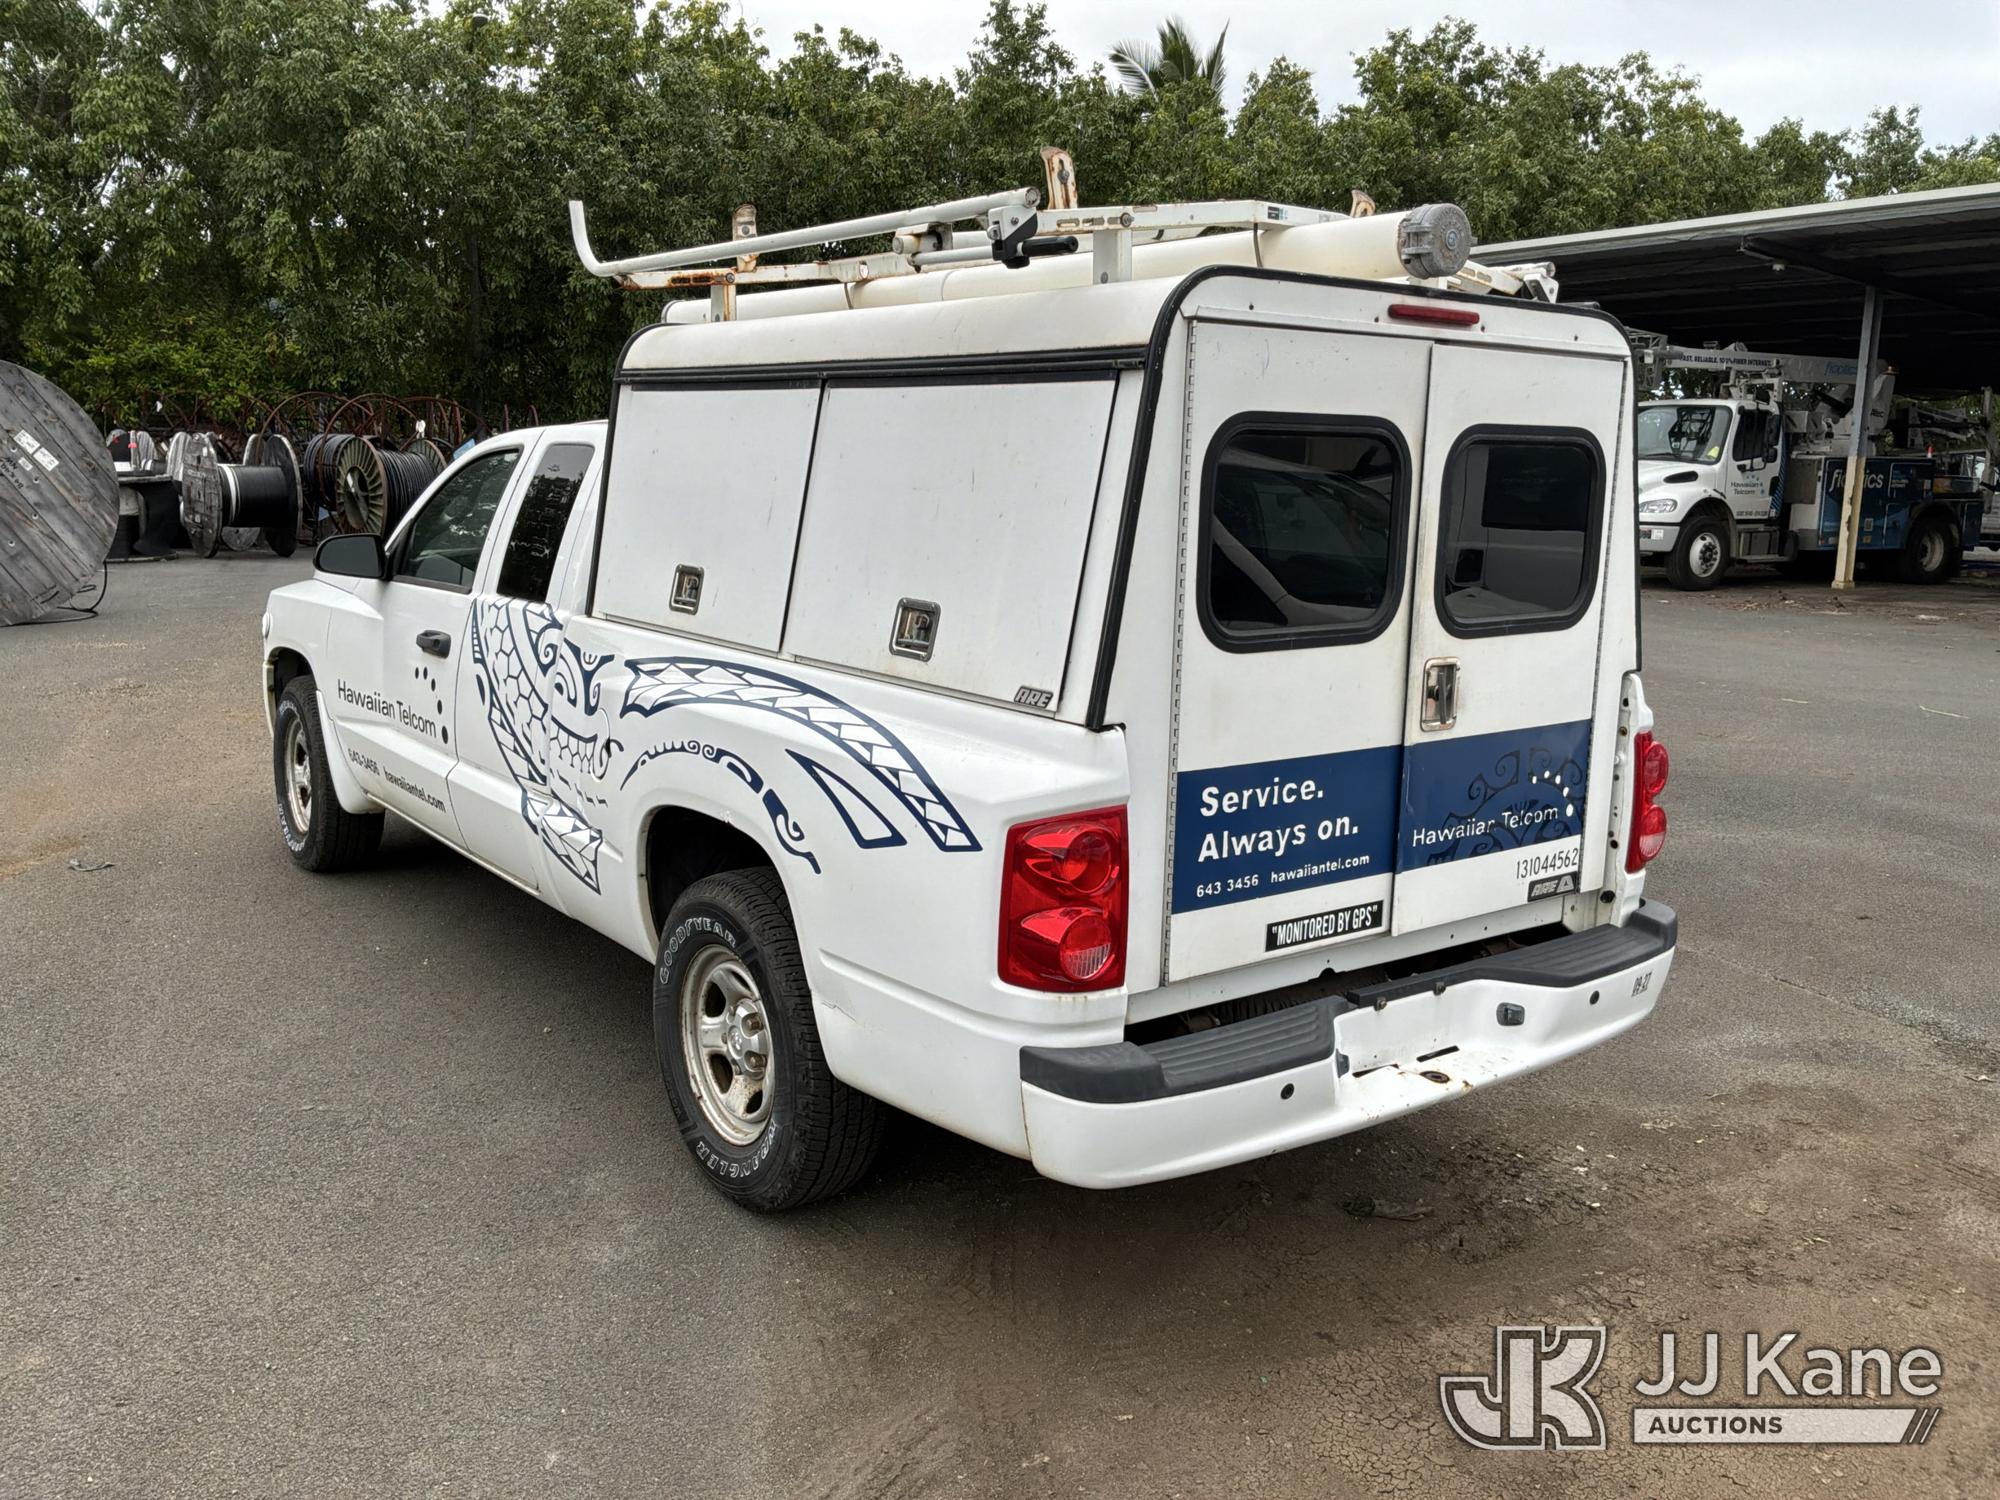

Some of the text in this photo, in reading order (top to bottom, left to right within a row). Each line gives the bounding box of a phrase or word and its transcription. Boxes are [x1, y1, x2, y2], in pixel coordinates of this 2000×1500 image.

[337, 679, 396, 719] Hawaiian
[396, 701, 437, 738] Telcom
[383, 766, 447, 813] hawaiiantel.com
[1200, 775, 1324, 817] Service.
[1197, 813, 1359, 862] Always on.
[1412, 806, 1558, 847] Hawaiian Telcom
[1196, 854, 1370, 898] 643 3456 hawaiiantel.com
[1516, 847, 1579, 880] 131044562
[1337, 909, 1351, 931] BY
[660, 916, 736, 985] GOODYEAR
[697, 1120, 778, 1178] WRANGLER
